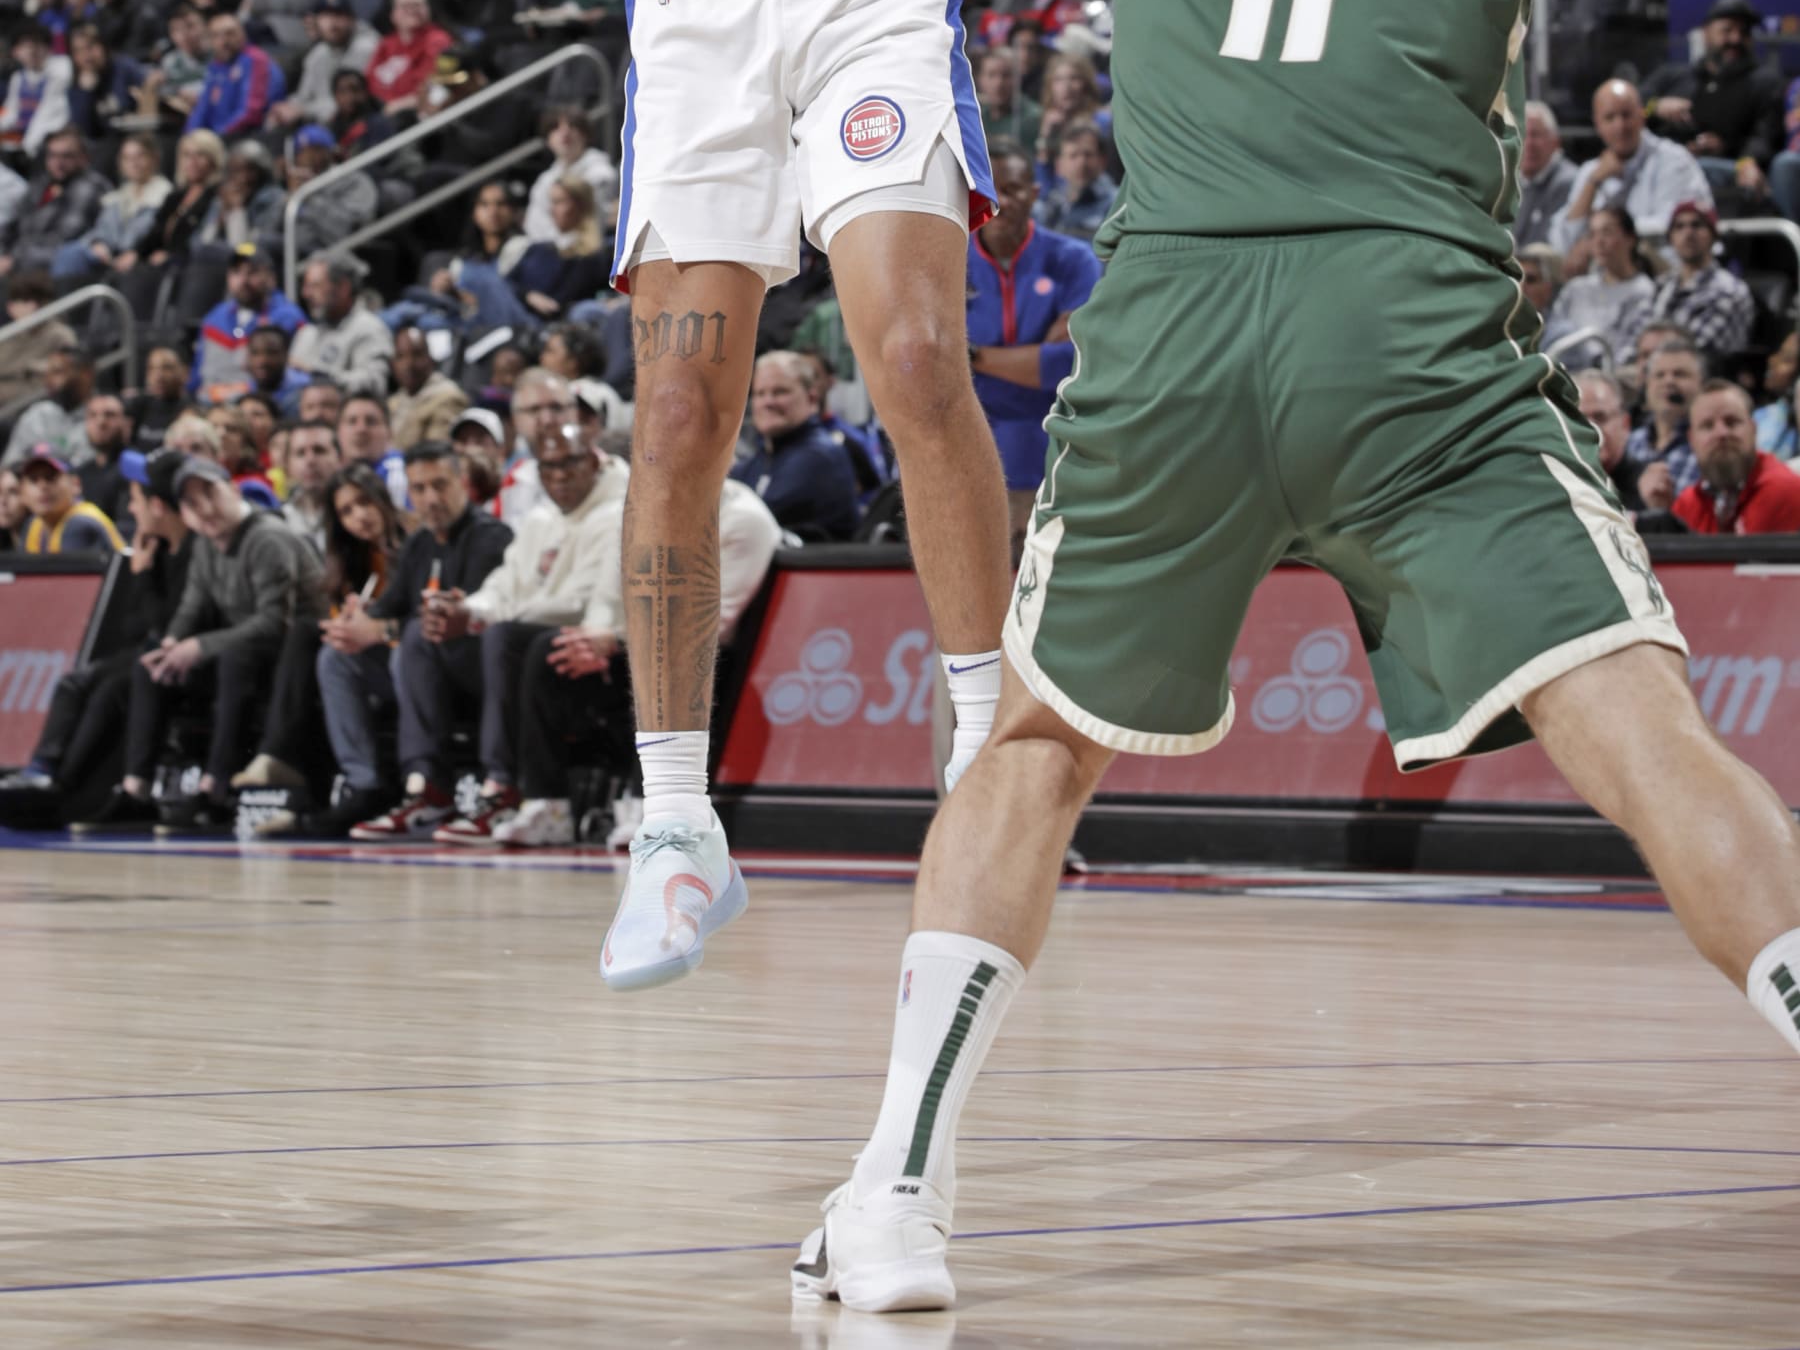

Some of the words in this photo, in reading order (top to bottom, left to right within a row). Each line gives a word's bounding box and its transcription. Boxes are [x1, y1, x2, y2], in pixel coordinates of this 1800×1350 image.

[850, 114, 891, 132] DETROIT
[851, 125, 892, 144] PISTONS
[634, 310, 727, 364] 2001
